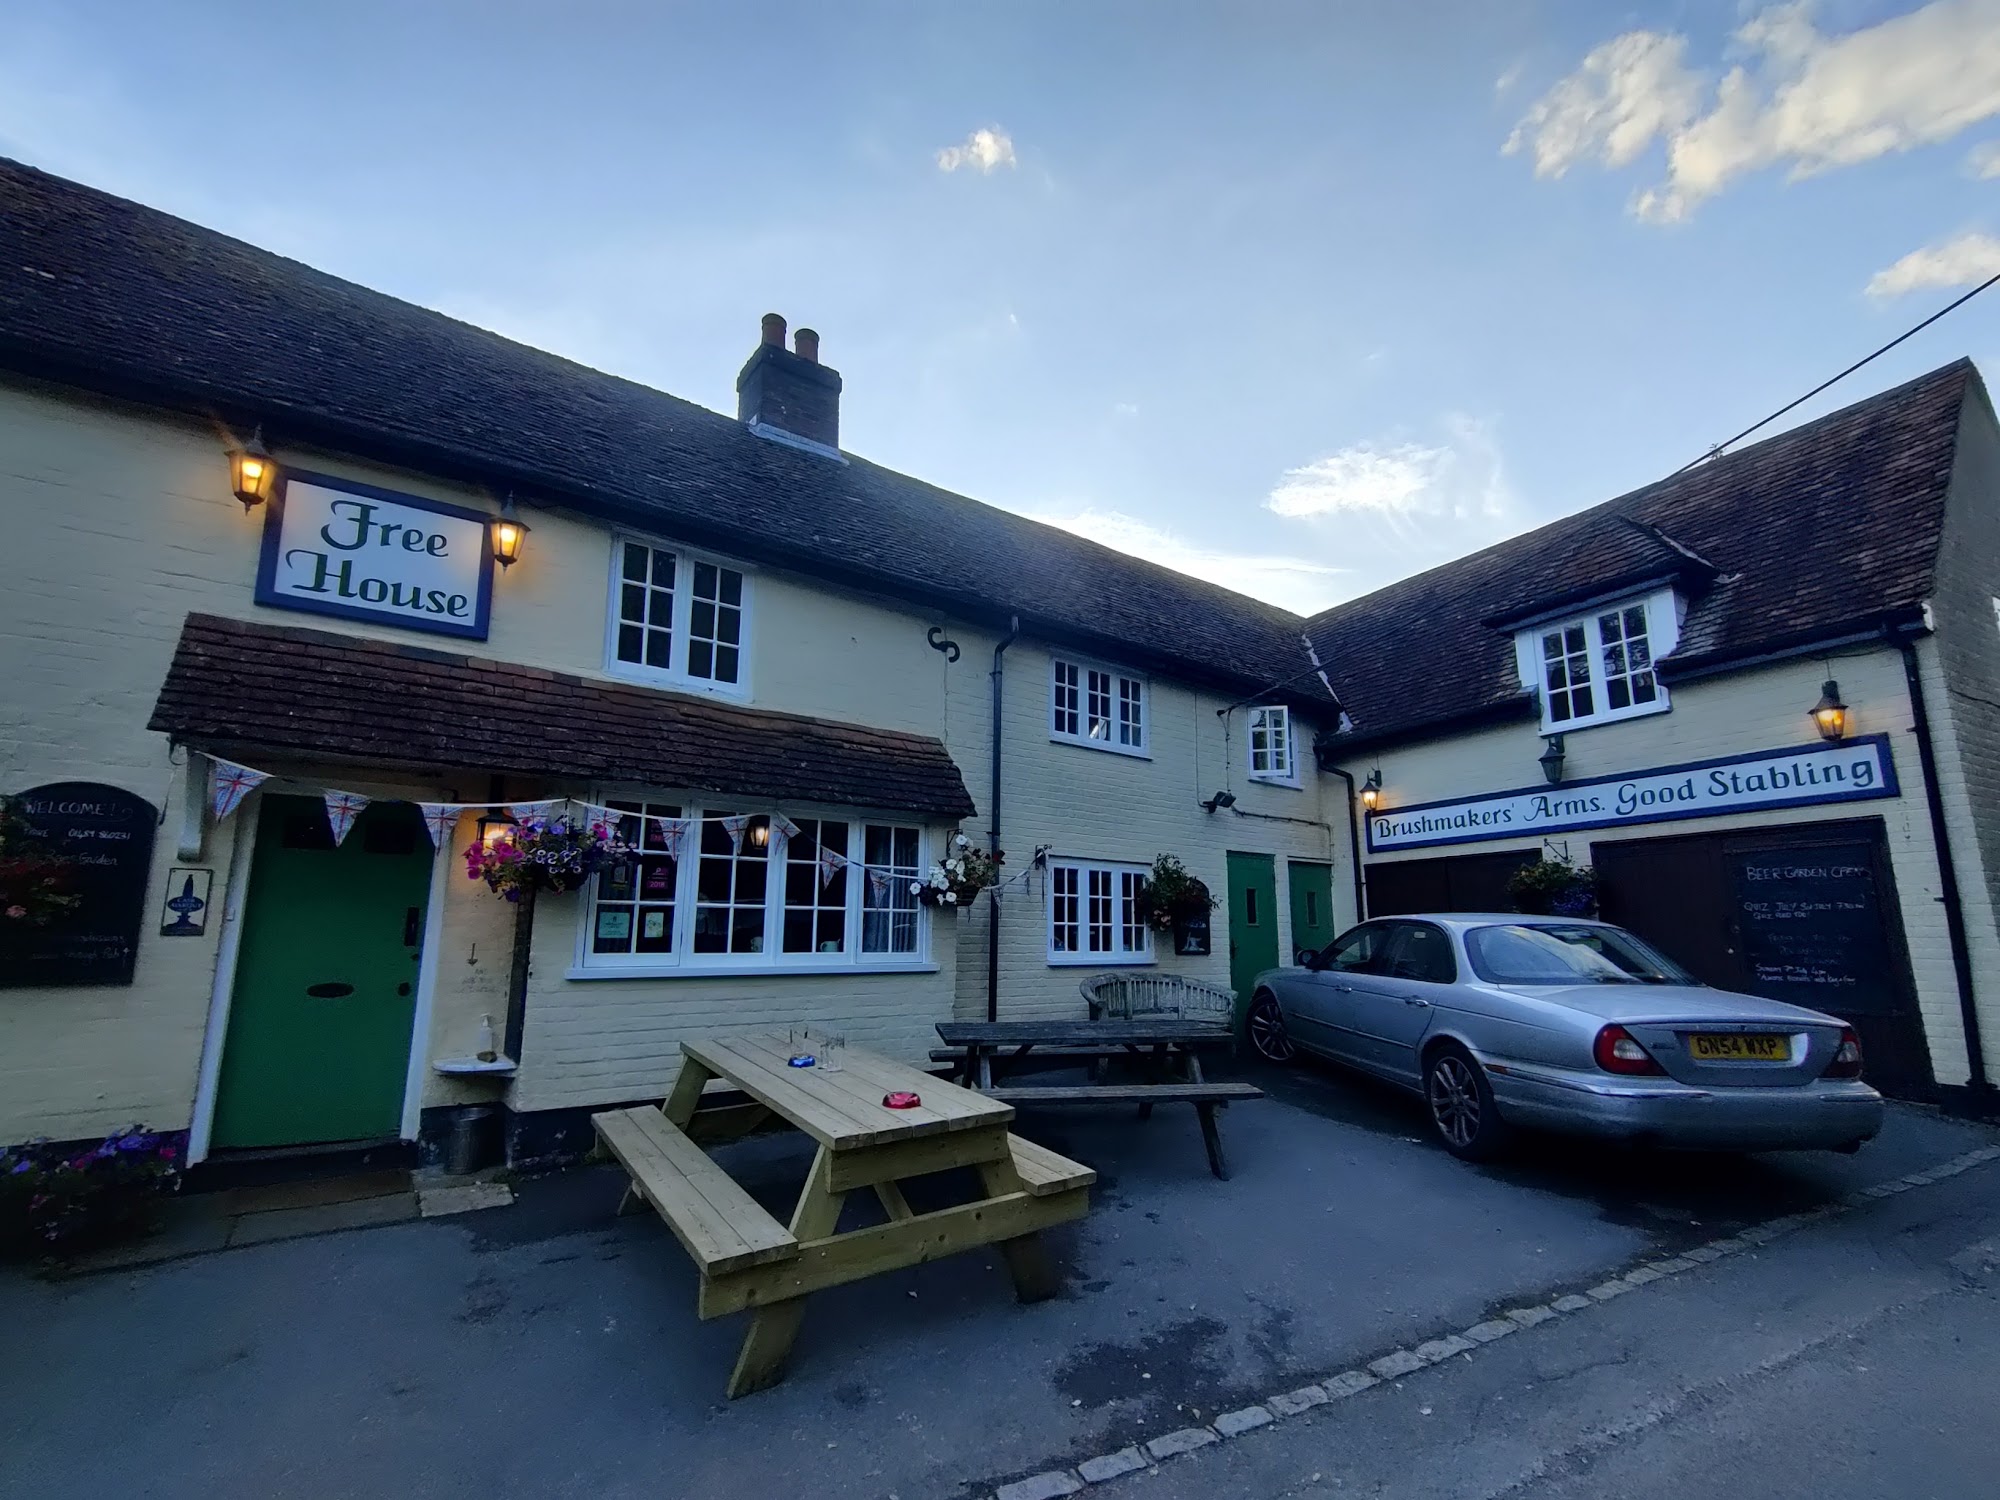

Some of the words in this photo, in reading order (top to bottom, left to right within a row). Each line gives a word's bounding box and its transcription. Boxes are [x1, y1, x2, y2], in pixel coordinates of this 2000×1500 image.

[321, 499, 448, 557] Free
[285, 548, 469, 617] House
[1375, 804, 1515, 838] Brushmakers'
[1523, 795, 1605, 822] Arms.
[1615, 778, 1697, 815] Good
[1708, 760, 1874, 797] Stabling
[1746, 866, 1782, 880] BEER
[1784, 866, 1827, 878] GARDEN
[1743, 902, 1769, 911] QUIZ
[1696, 1036, 1742, 1055] GN54
[1746, 1037, 1777, 1055] WXP
